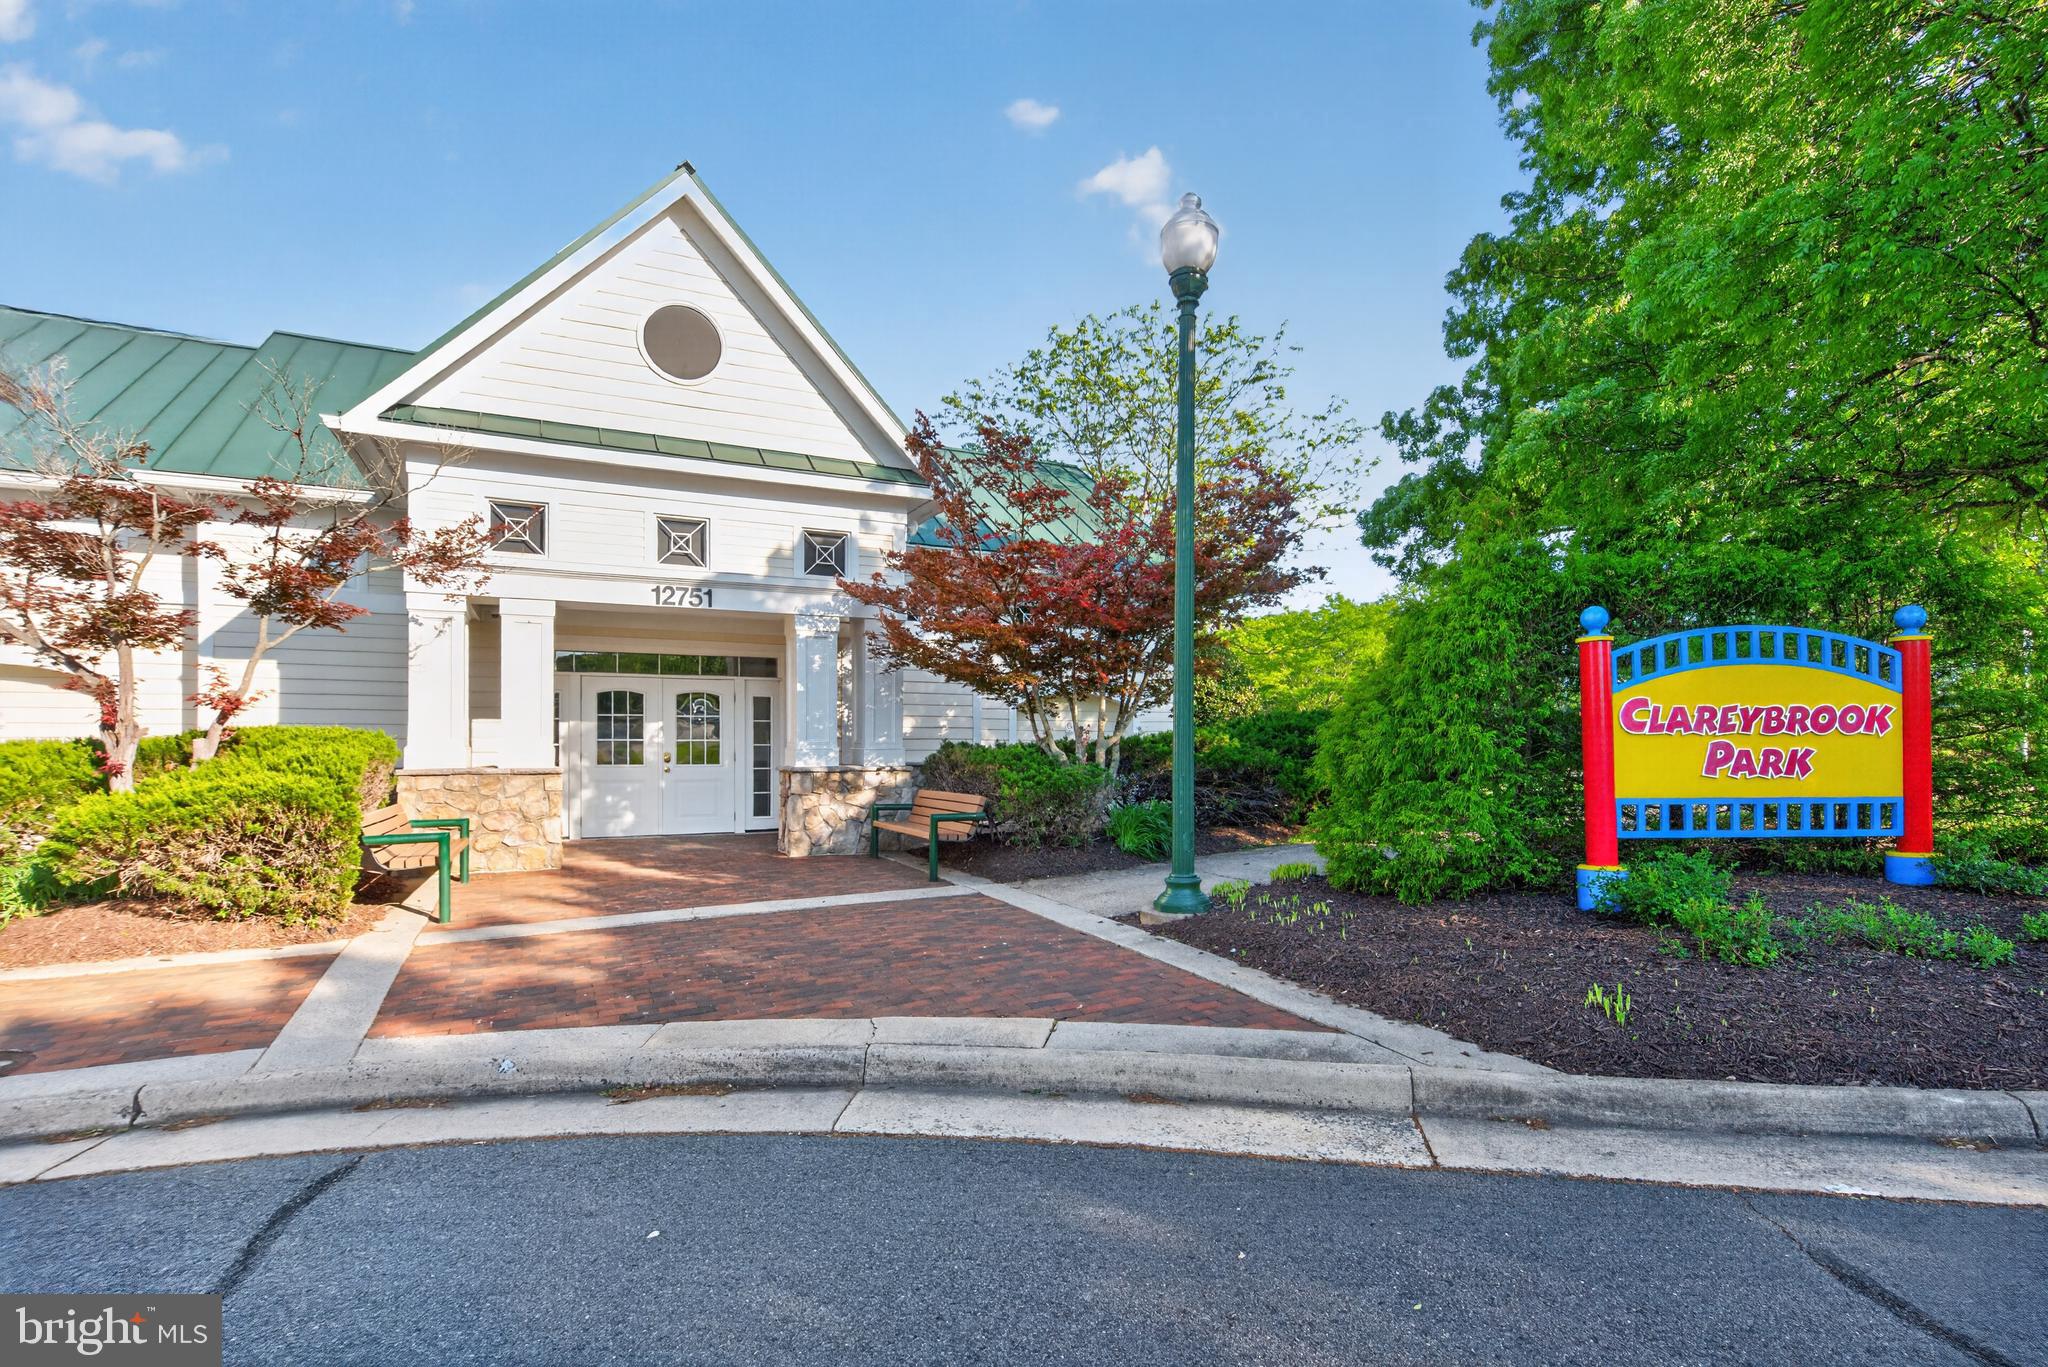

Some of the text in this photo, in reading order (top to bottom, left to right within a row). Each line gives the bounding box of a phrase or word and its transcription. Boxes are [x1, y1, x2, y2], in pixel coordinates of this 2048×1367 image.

[651, 585, 713, 608] 12751
[1619, 696, 1896, 737] CLAREYBROOK
[1702, 739, 1816, 780] PARK
